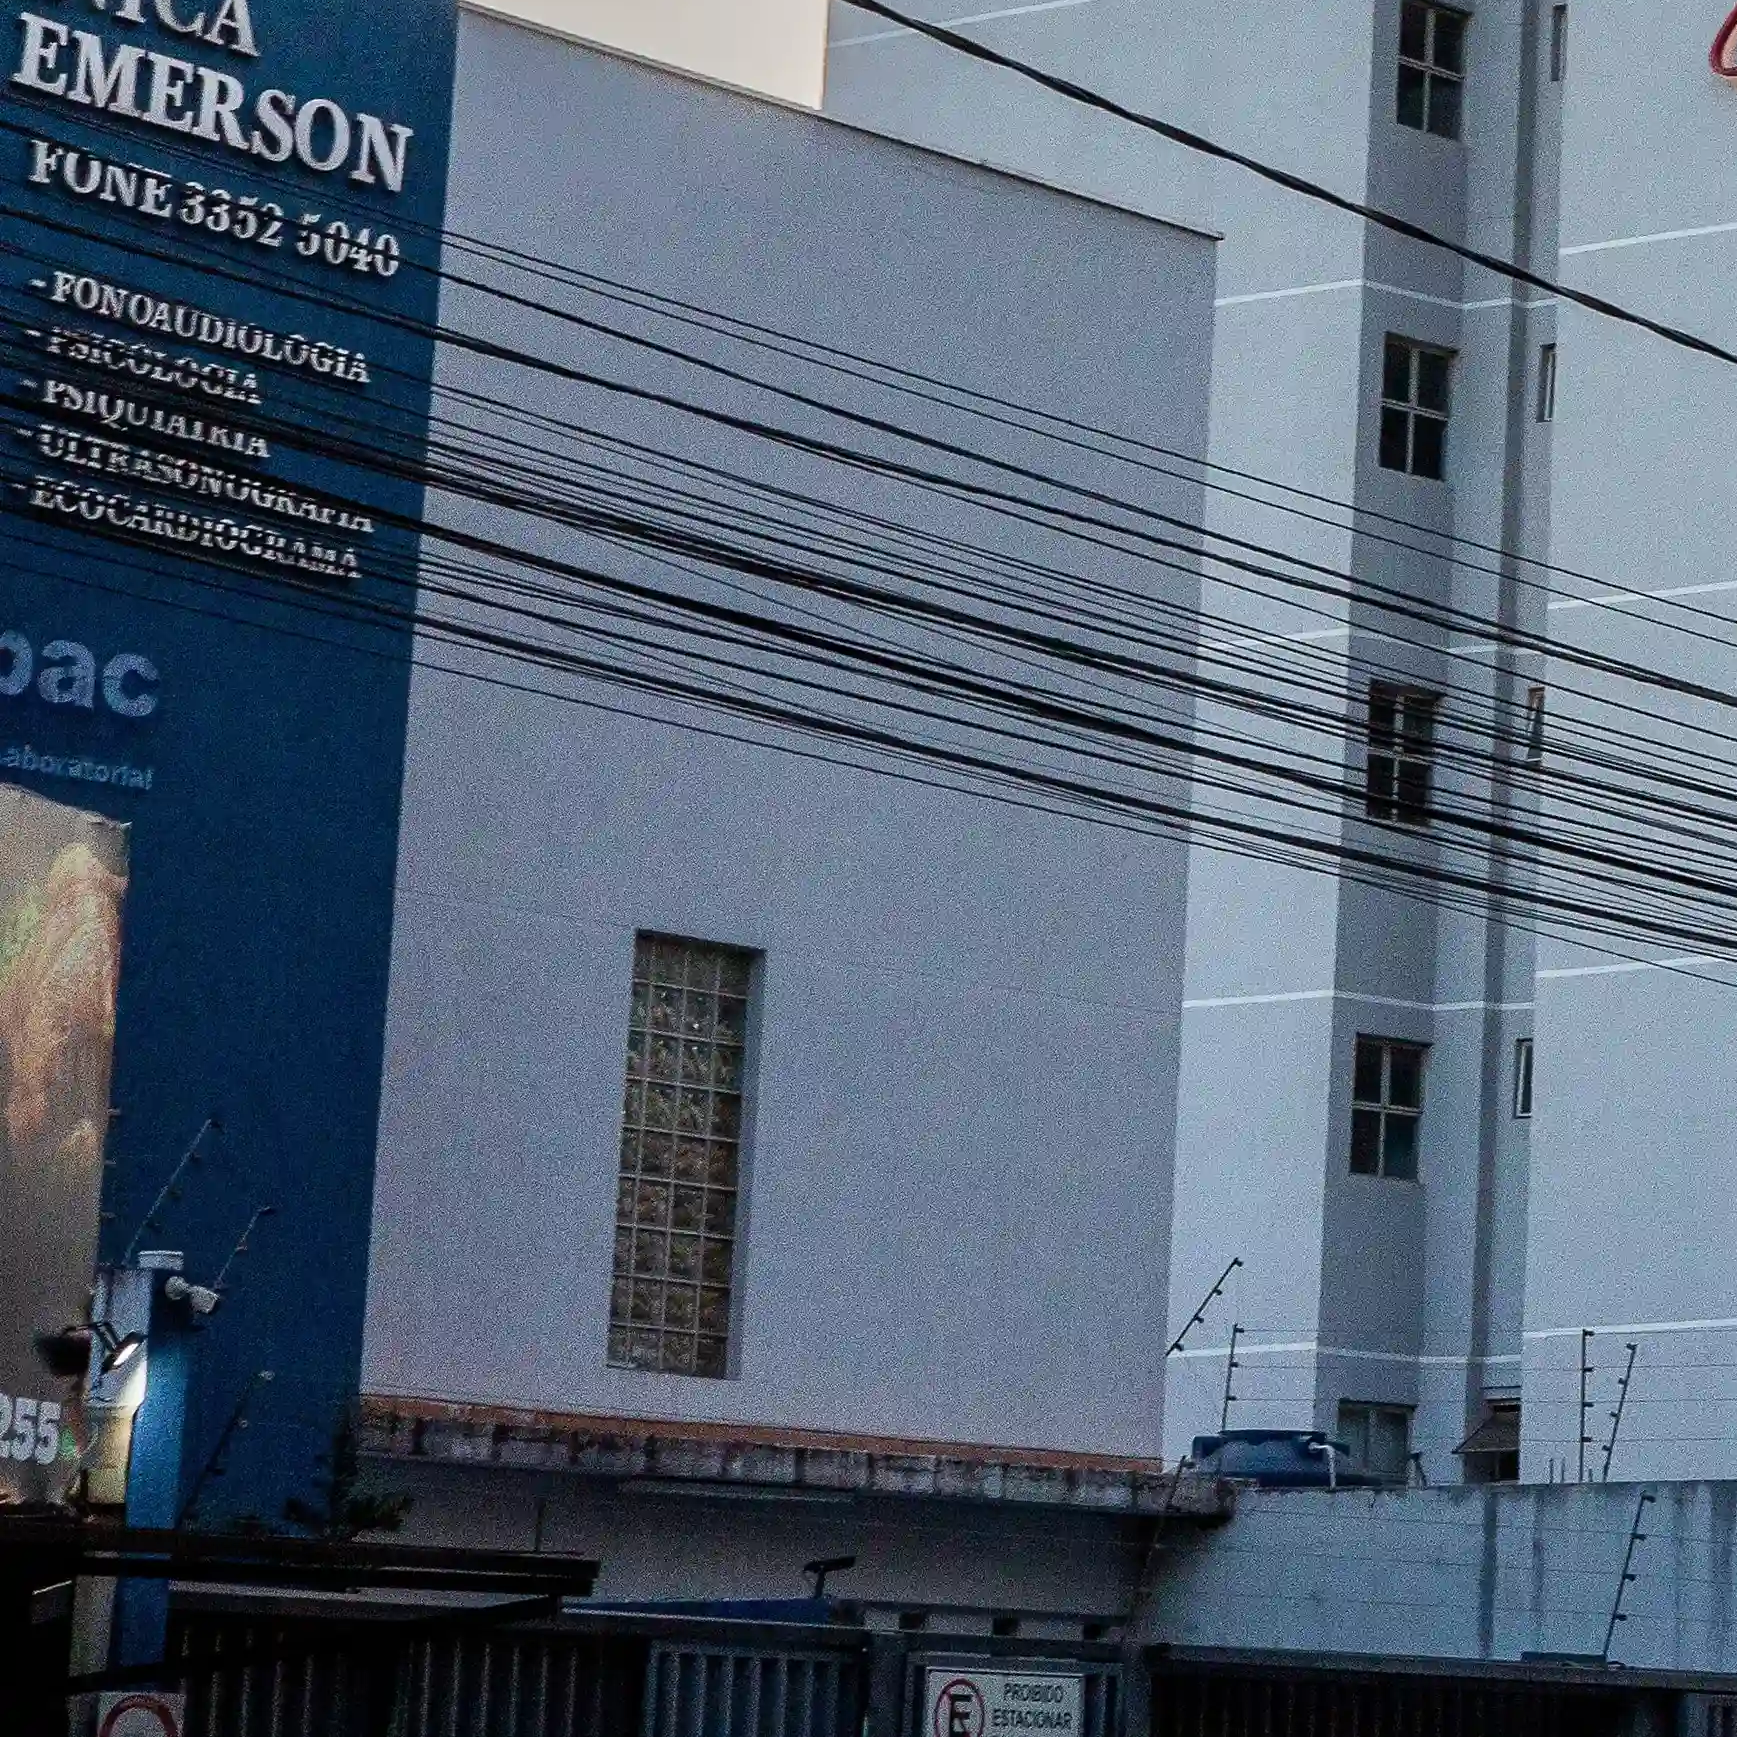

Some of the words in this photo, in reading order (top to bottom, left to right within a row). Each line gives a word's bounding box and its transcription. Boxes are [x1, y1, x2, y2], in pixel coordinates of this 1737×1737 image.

[10, 12, 414, 193] EMERSON
[180, 181, 284, 248] 3352
[52, 271, 372, 384] FONOAUDIOLOGIA
[0, 744, 155, 791] aboratorial
[991, 1708, 1072, 1730] ESTACIONAR
[1003, 1682, 1065, 1703] PROIBIDO
